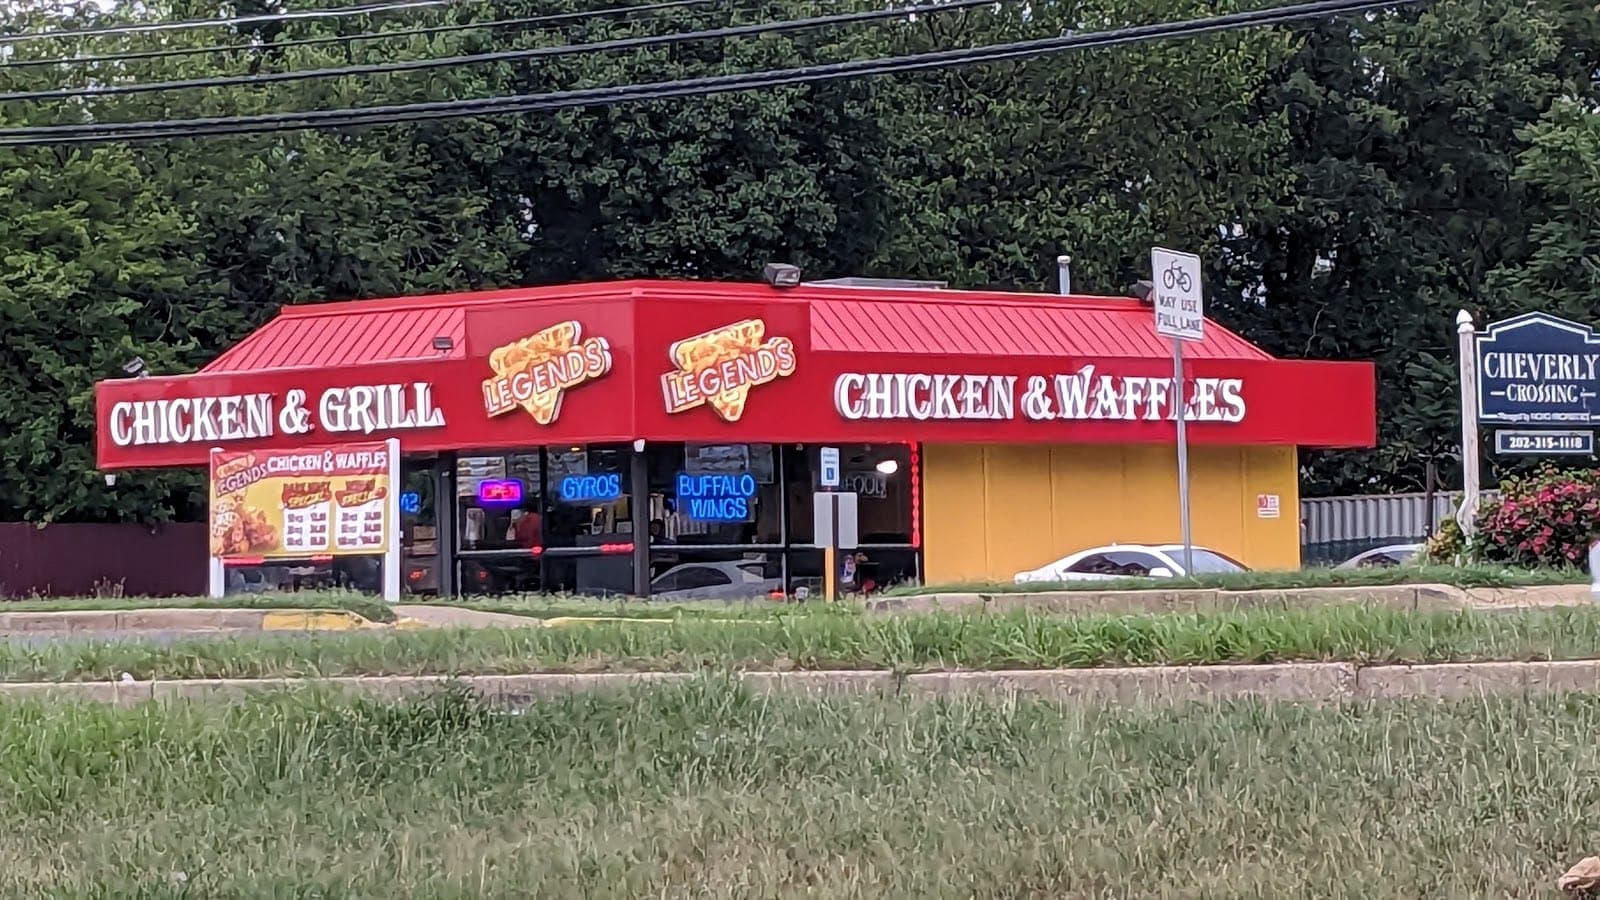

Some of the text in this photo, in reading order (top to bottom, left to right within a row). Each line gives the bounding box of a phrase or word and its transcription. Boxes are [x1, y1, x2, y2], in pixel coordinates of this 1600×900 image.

[1158, 312, 1202, 332] FULL LANE
[485, 342, 604, 413] LEGENDS
[666, 342, 794, 408] LEGENDS
[1484, 352, 1600, 381] CHEVERLY
[835, 364, 1246, 422] CHICKEN & WAFFLES
[1506, 383, 1579, 403] CROSSING
[110, 382, 446, 446] CHICKEN & GRILL
[267, 450, 387, 473] CHICKEN & WAFFLES
[562, 474, 619, 498] GYROS
[678, 474, 755, 497] BUFFALO
[690, 498, 748, 519] WINGS
